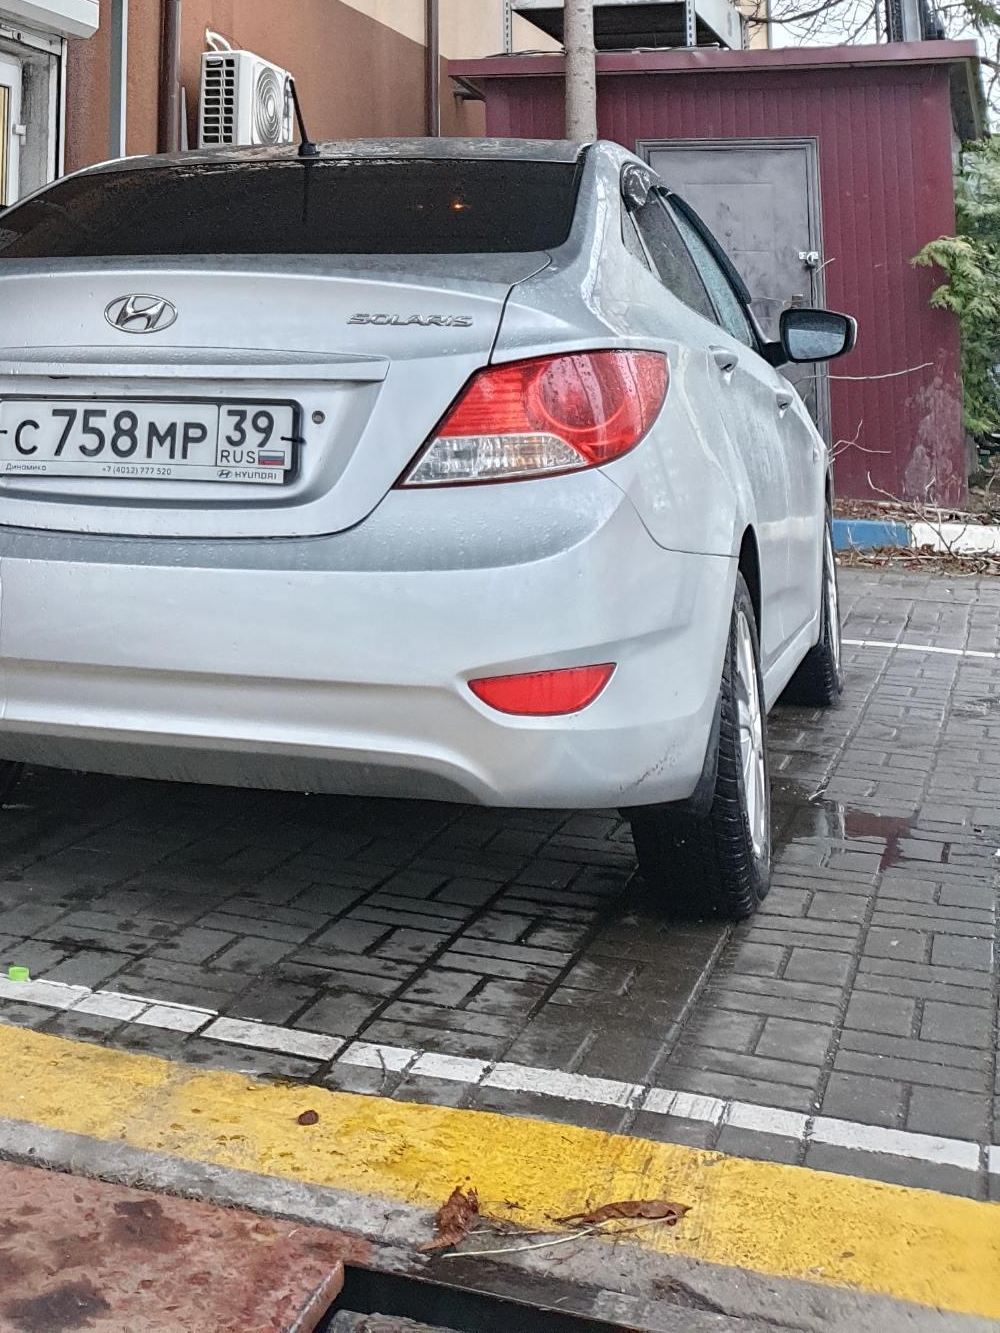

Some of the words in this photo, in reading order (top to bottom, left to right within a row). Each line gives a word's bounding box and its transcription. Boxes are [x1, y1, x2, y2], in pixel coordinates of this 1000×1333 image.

[346, 313, 474, 327] SOLARIS
[225, 410, 275, 448] 39
[220, 449, 256, 464] RUS
[234, 471, 277, 480] HYUNDAI
